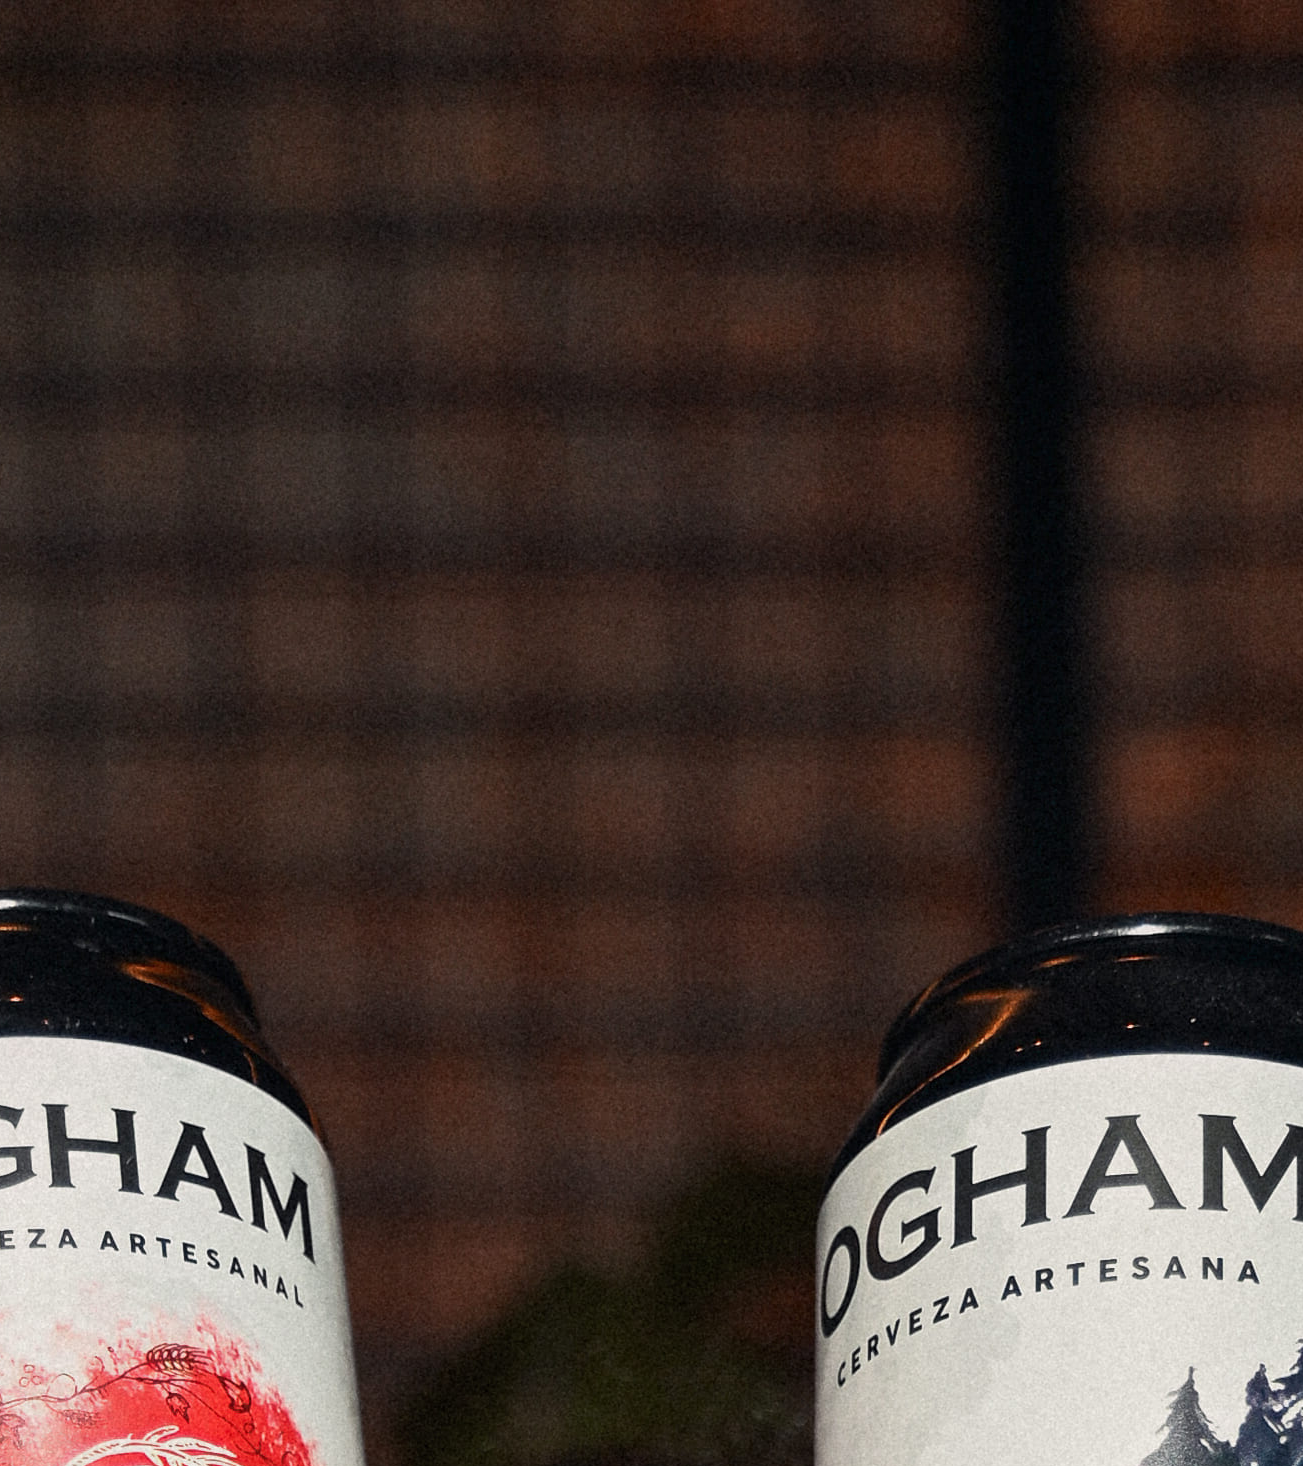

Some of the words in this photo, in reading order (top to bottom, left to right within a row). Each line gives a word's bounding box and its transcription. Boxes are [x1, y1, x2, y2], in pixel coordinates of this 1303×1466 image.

[100, 1230, 305, 1309] ARTESANAL
[836, 1287, 980, 1389] CERVEZA
[1000, 1256, 1261, 1301] ARTESANA
